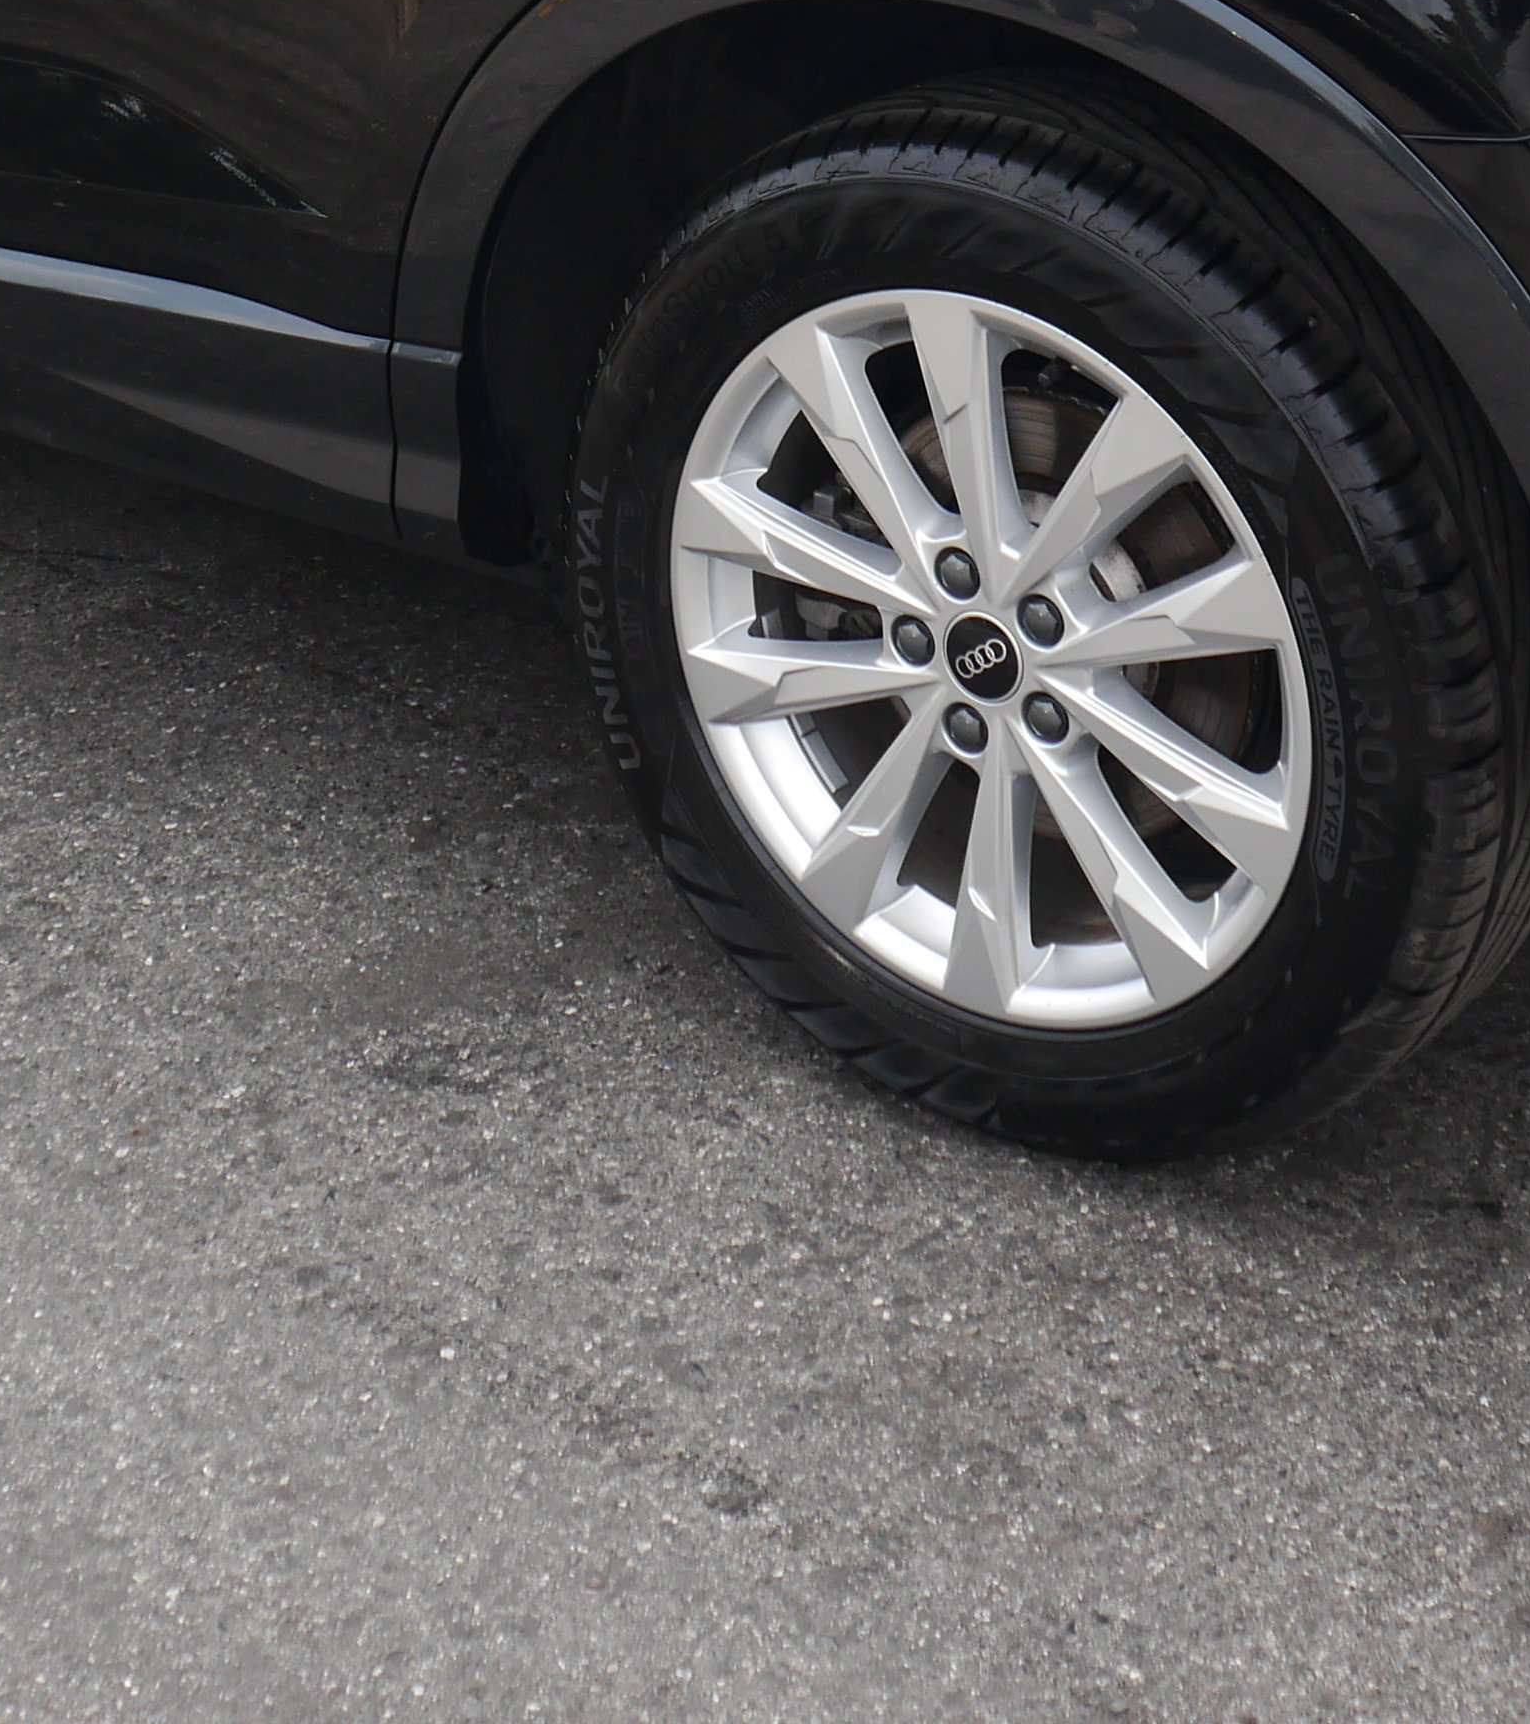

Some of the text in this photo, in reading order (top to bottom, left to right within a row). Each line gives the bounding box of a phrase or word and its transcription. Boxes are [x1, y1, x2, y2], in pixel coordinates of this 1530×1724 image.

[577, 475, 642, 770] UNIROYAL
[1294, 591, 1345, 864] THE RAIN TYRE
